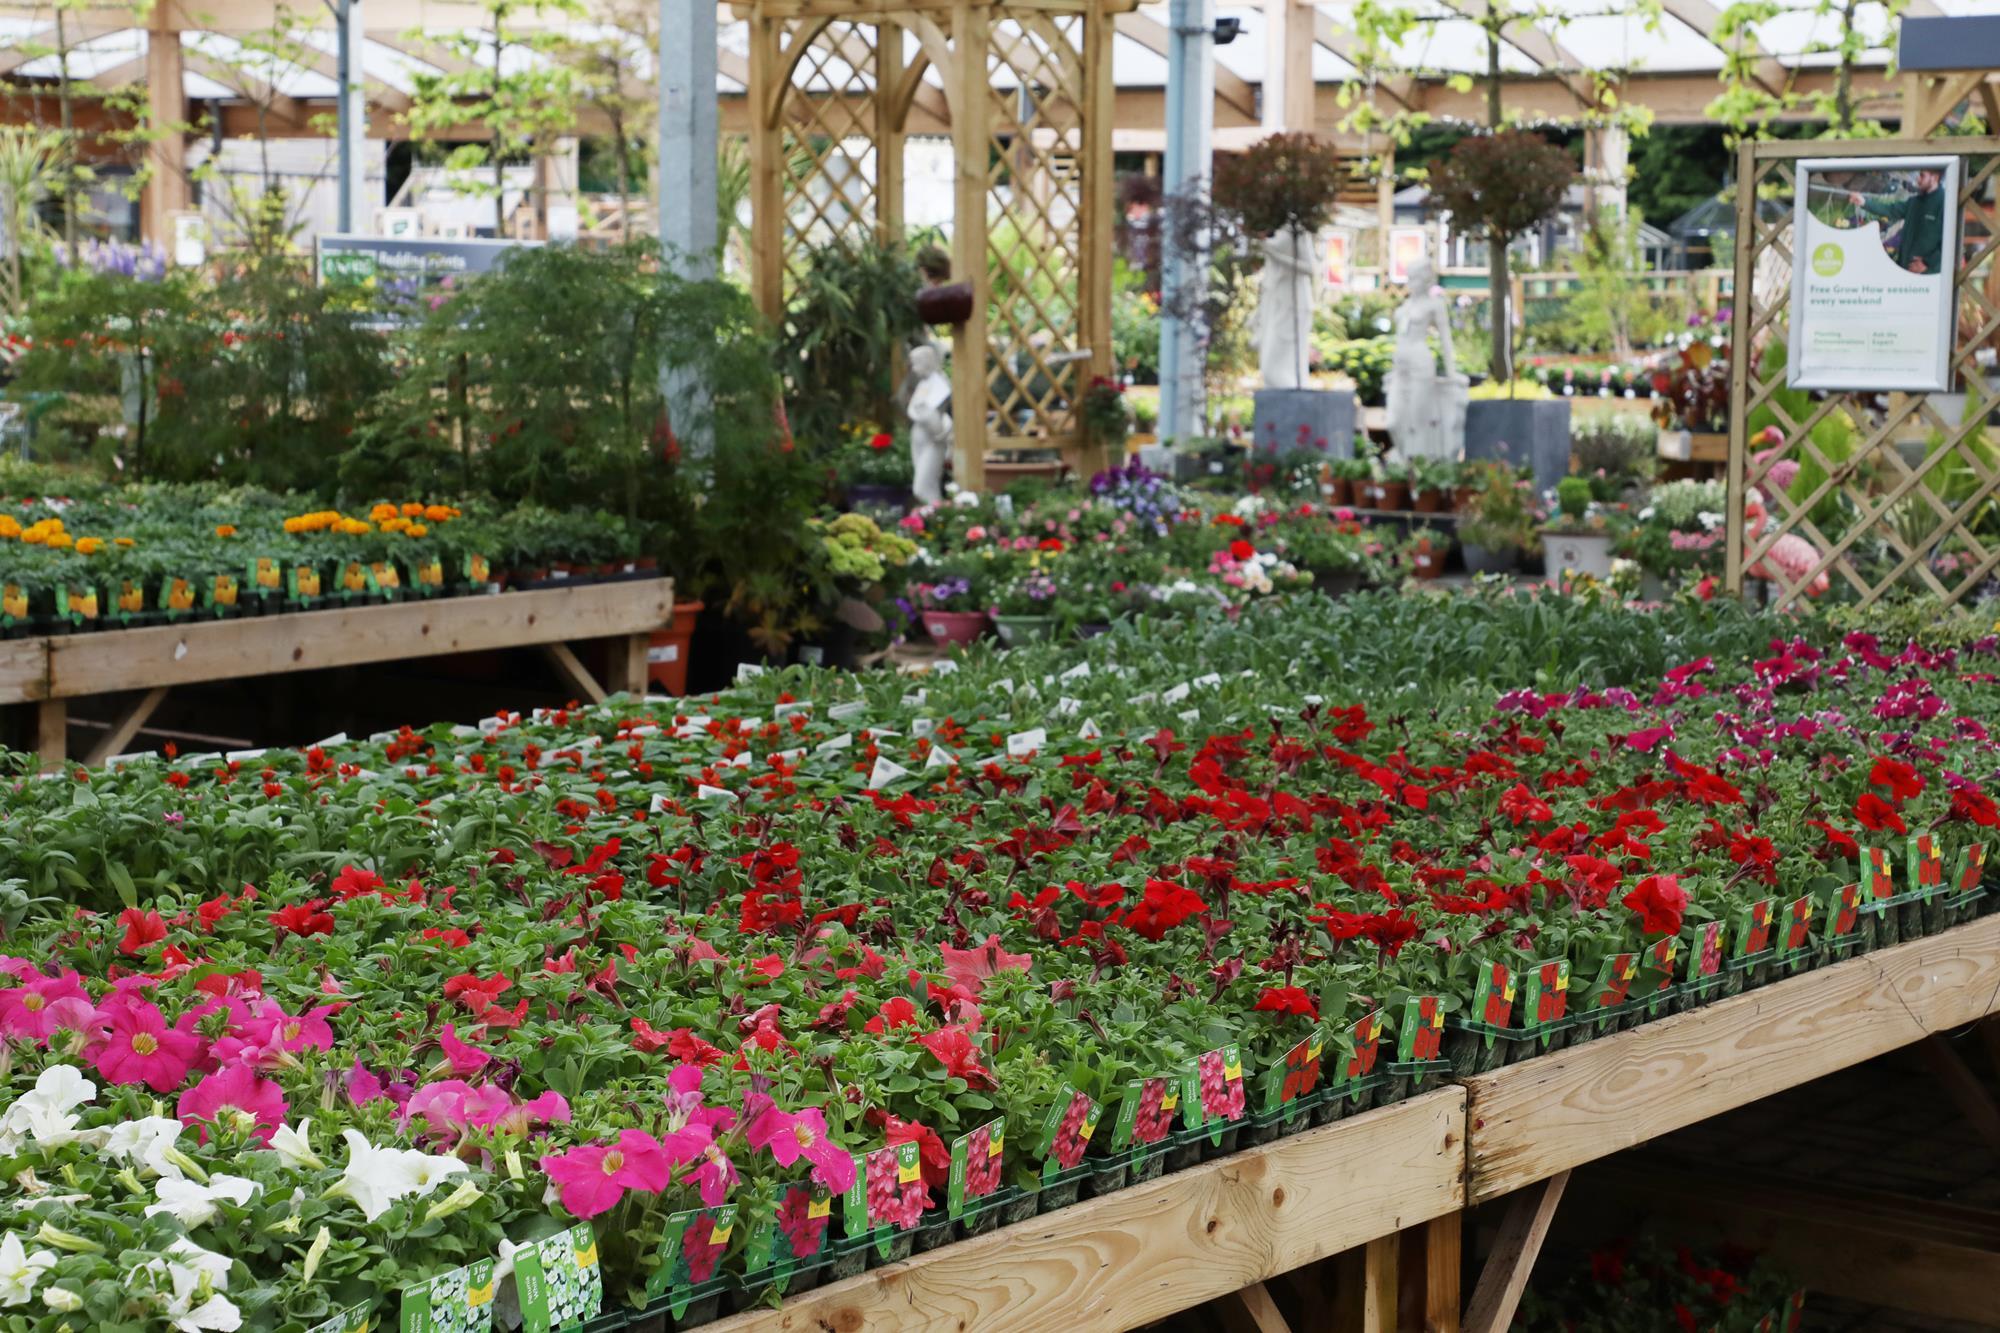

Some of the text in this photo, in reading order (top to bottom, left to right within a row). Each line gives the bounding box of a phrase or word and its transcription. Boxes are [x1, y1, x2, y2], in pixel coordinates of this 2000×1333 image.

[1810, 284, 1930, 293] Free Grow How sessions
[1810, 296, 1882, 307] every weekend
[580, 1227, 589, 1236] for
[580, 1235, 588, 1246] £9
[479, 1264, 489, 1274] for
[476, 1273, 486, 1284] £9
[525, 1276, 534, 1305] Petunia
